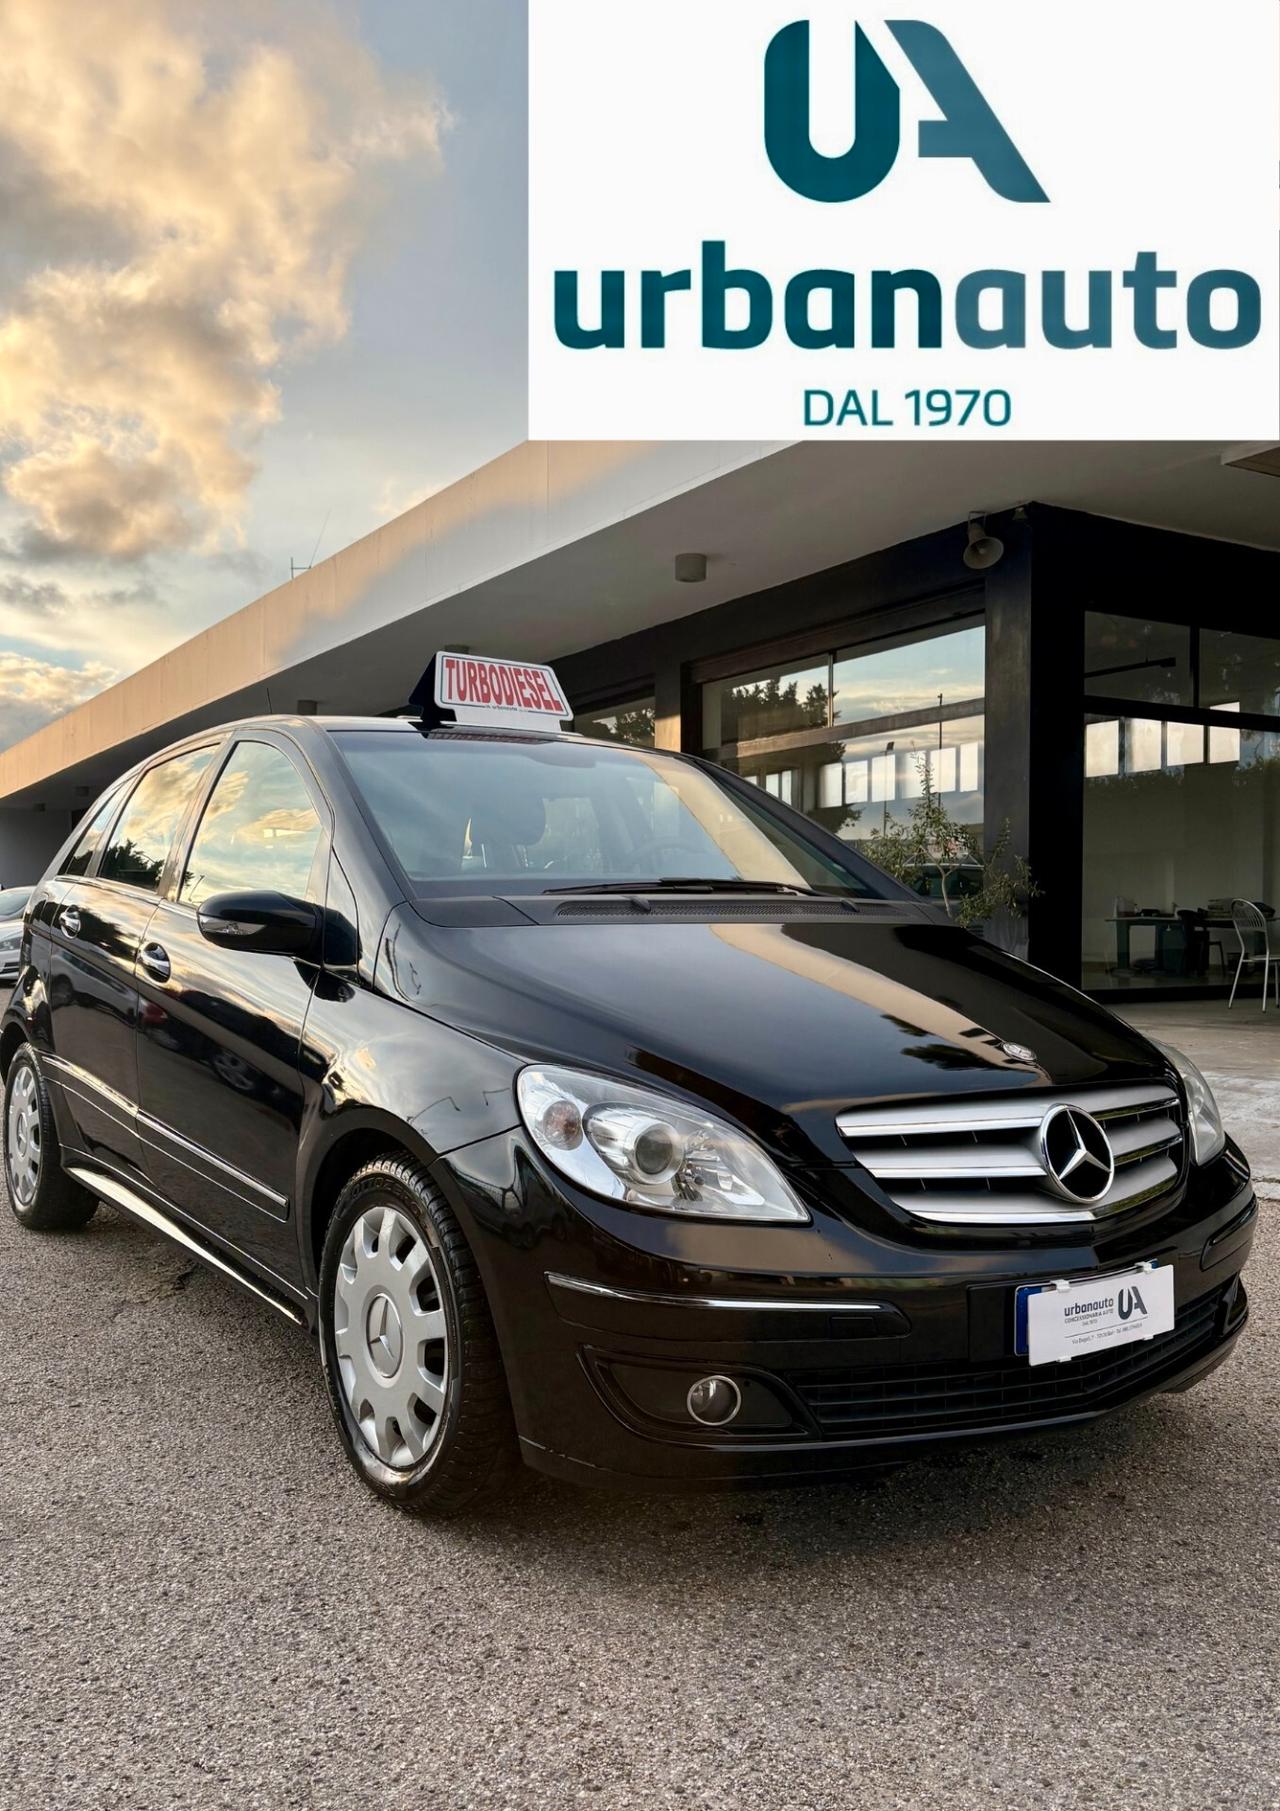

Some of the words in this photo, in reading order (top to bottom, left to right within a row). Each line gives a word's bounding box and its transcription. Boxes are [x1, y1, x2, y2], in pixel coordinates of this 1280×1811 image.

[445, 658, 564, 712] TURBODIESEL
[1064, 1298, 1114, 1317] urbanauto
[1118, 1286, 1148, 1320] UA
